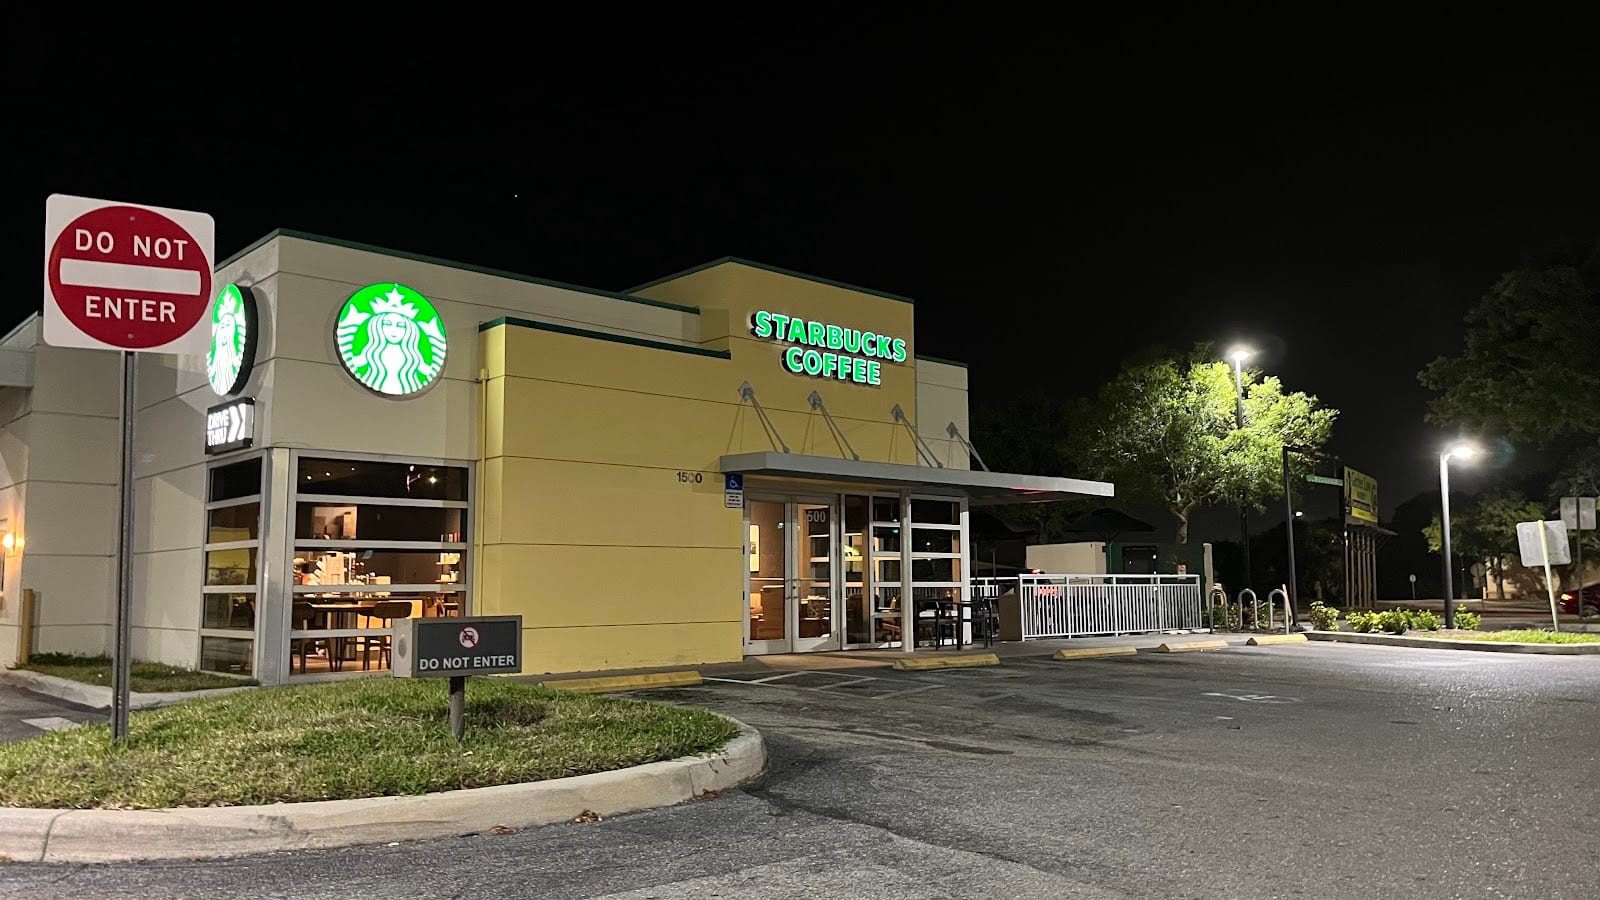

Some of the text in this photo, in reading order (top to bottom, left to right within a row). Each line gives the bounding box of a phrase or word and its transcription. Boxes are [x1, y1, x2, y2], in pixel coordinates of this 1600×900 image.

[75, 228, 188, 261] DO NOT
[85, 295, 176, 323] ENTER
[754, 310, 907, 363] STARBUCKS
[785, 346, 881, 386] COFFEE
[207, 409, 229, 430] DRIVE
[207, 427, 227, 446] THRU
[676, 471, 703, 484] 1500
[419, 655, 515, 670] DO NOT ENTER
